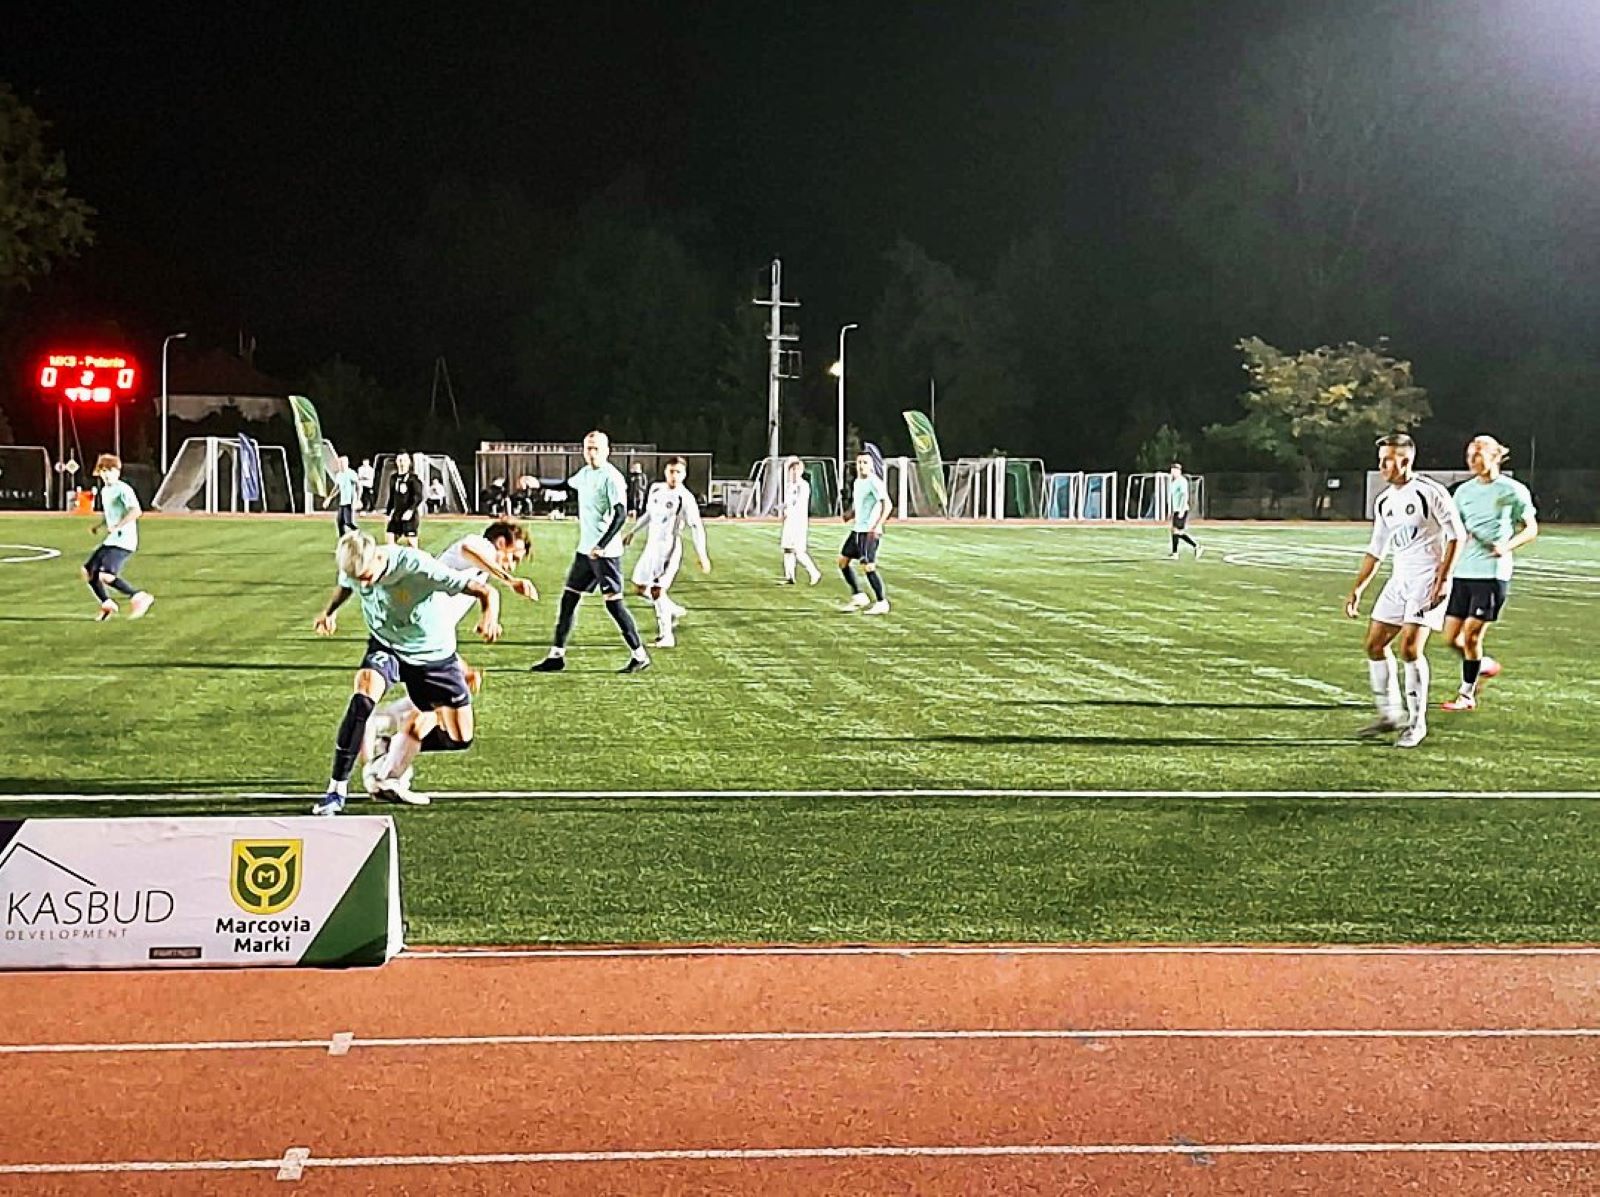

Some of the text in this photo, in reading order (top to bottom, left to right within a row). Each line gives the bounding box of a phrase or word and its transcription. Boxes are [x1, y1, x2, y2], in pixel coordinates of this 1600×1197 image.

[41, 367, 57, 388] 0
[117, 369, 134, 389] 0
[8, 890, 174, 925] KASBUD
[216, 915, 310, 933] Marcovia
[5, 928, 128, 940] DEVELOPMENT
[234, 936, 290, 953] Marki
